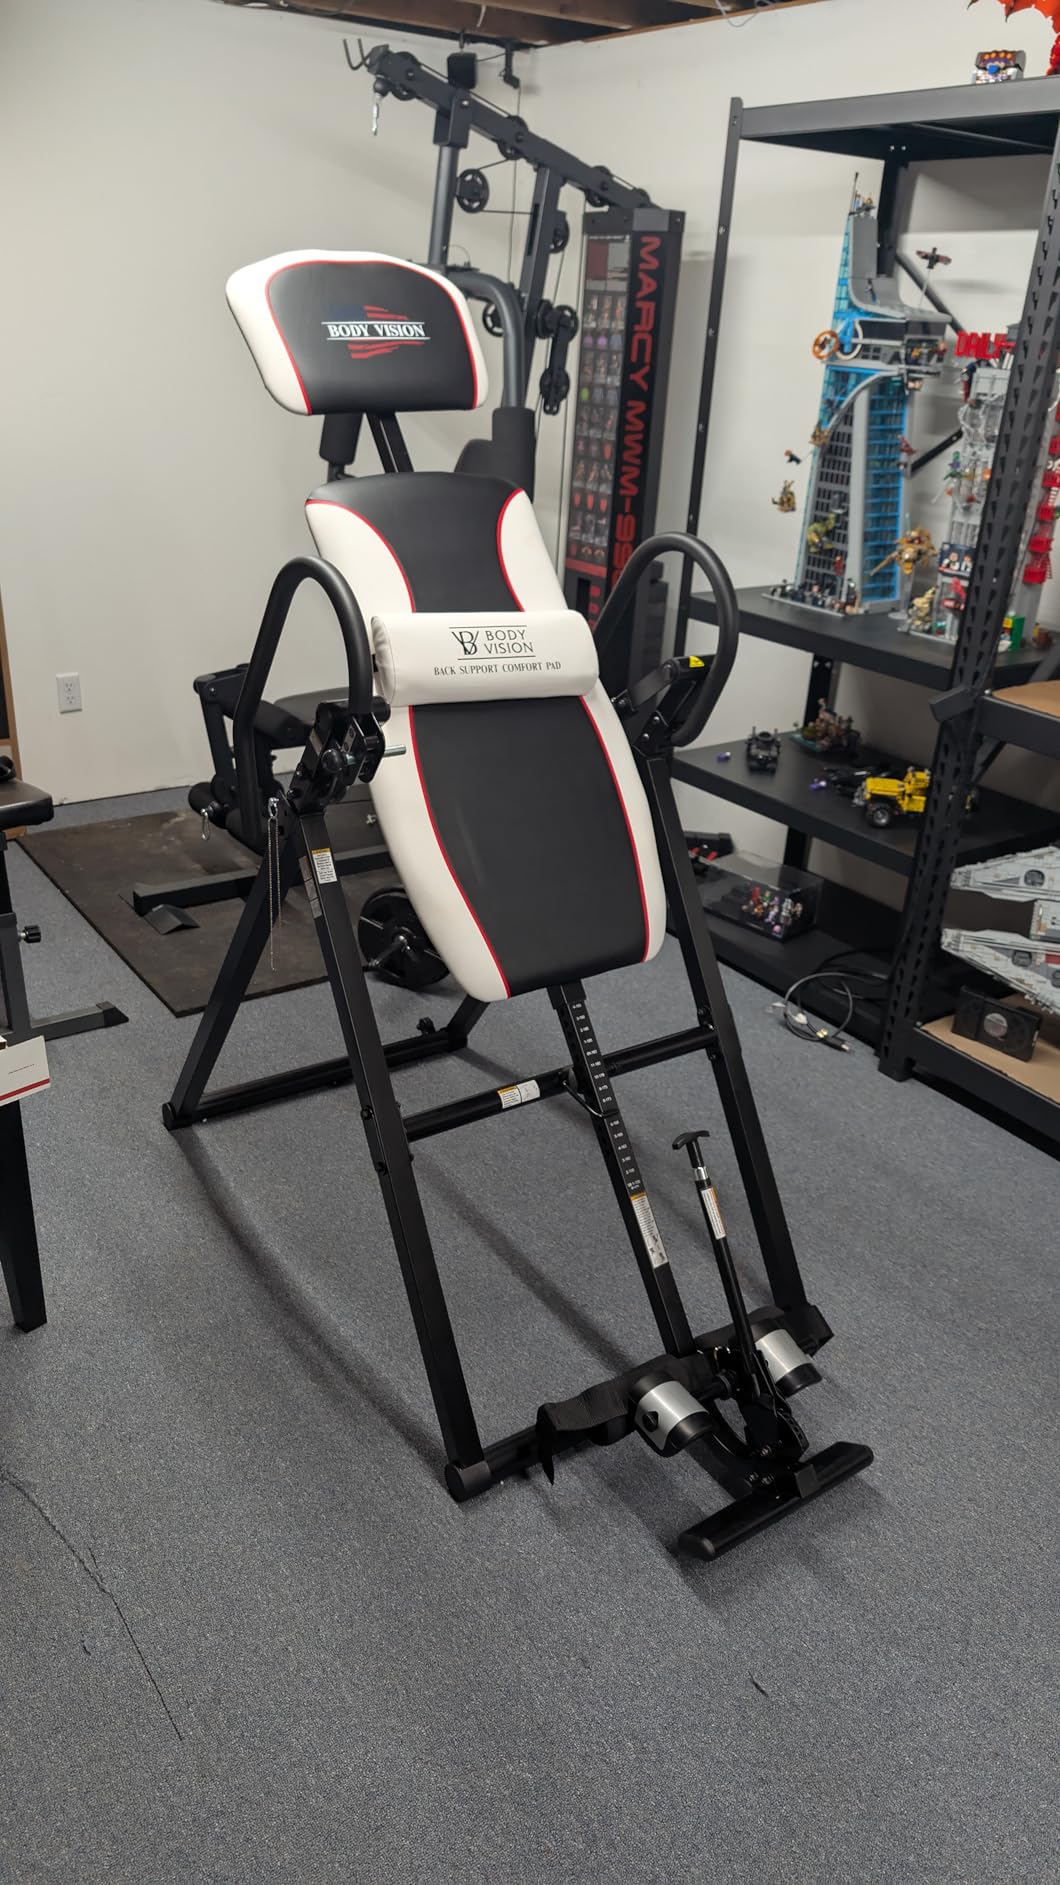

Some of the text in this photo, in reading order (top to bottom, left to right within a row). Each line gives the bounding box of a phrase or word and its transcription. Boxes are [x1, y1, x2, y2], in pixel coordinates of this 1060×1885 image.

[327, 324, 426, 337] BODY VISION
[611, 235, 661, 593] MARCY MWM-99
[485, 629, 526, 641] BODY
[484, 642, 535, 654] VISION
[434, 661, 562, 676] BACK SUPPORT COMFORT PAD
